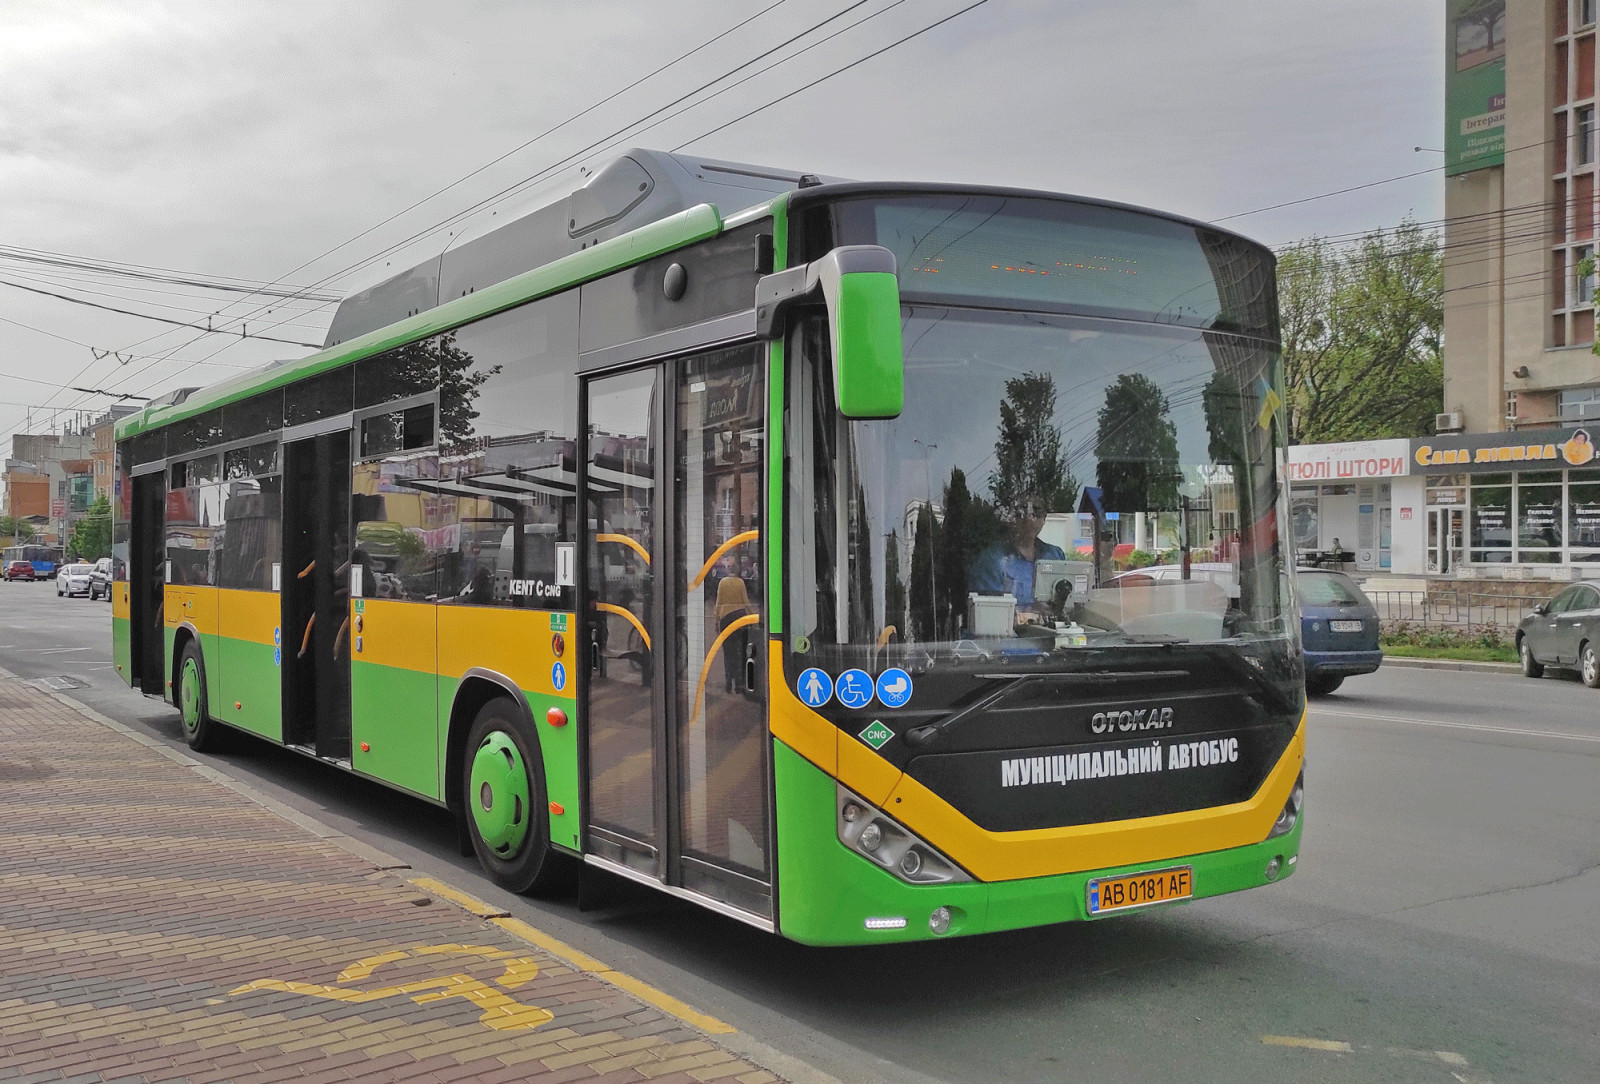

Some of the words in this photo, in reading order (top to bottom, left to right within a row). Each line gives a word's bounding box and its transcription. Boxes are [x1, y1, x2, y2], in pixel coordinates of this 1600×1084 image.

[1336, 457, 1403, 477] ШТОРИ
[509, 579, 535, 597] KENT
[535, 580, 544, 597] C
[545, 584, 561, 597] CNG
[1091, 707, 1174, 734] OTOKAR
[867, 730, 887, 739] CNG
[1001, 740, 1162, 787] МУНІЦИПАЛЬНИЙ
[1168, 737, 1238, 770] АВТОБУС
[1102, 883, 1125, 907] AB
[1129, 877, 1164, 902] 0181
[1168, 873, 1189, 896] AF
